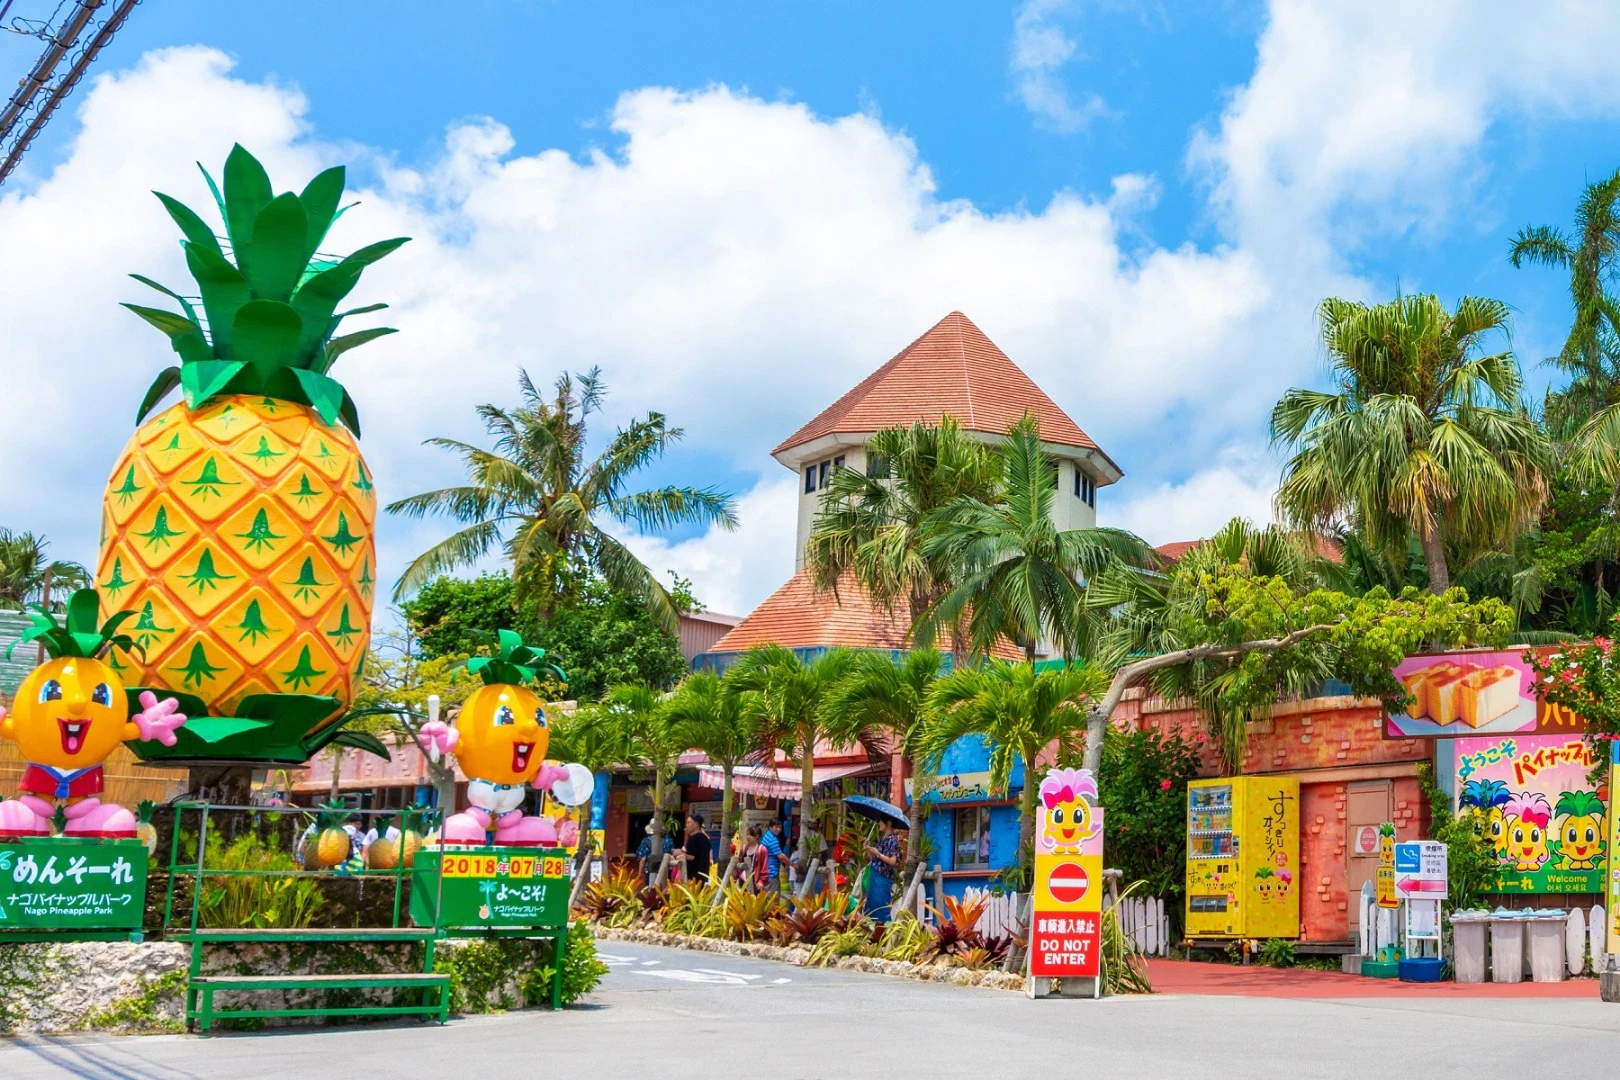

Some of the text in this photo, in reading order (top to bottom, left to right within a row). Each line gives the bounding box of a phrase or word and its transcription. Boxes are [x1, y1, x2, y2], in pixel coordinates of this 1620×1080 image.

[1459, 739, 1516, 778] ようこそ
[1267, 790, 1294, 848] すっきり
[13, 854, 133, 885] めんそーれ
[1547, 874, 1588, 883] Welcome
[24, 907, 113, 916] Nago Pineapple Park
[1040, 940, 1091, 951] DO NOT
[1044, 953, 1086, 965] ENTER
